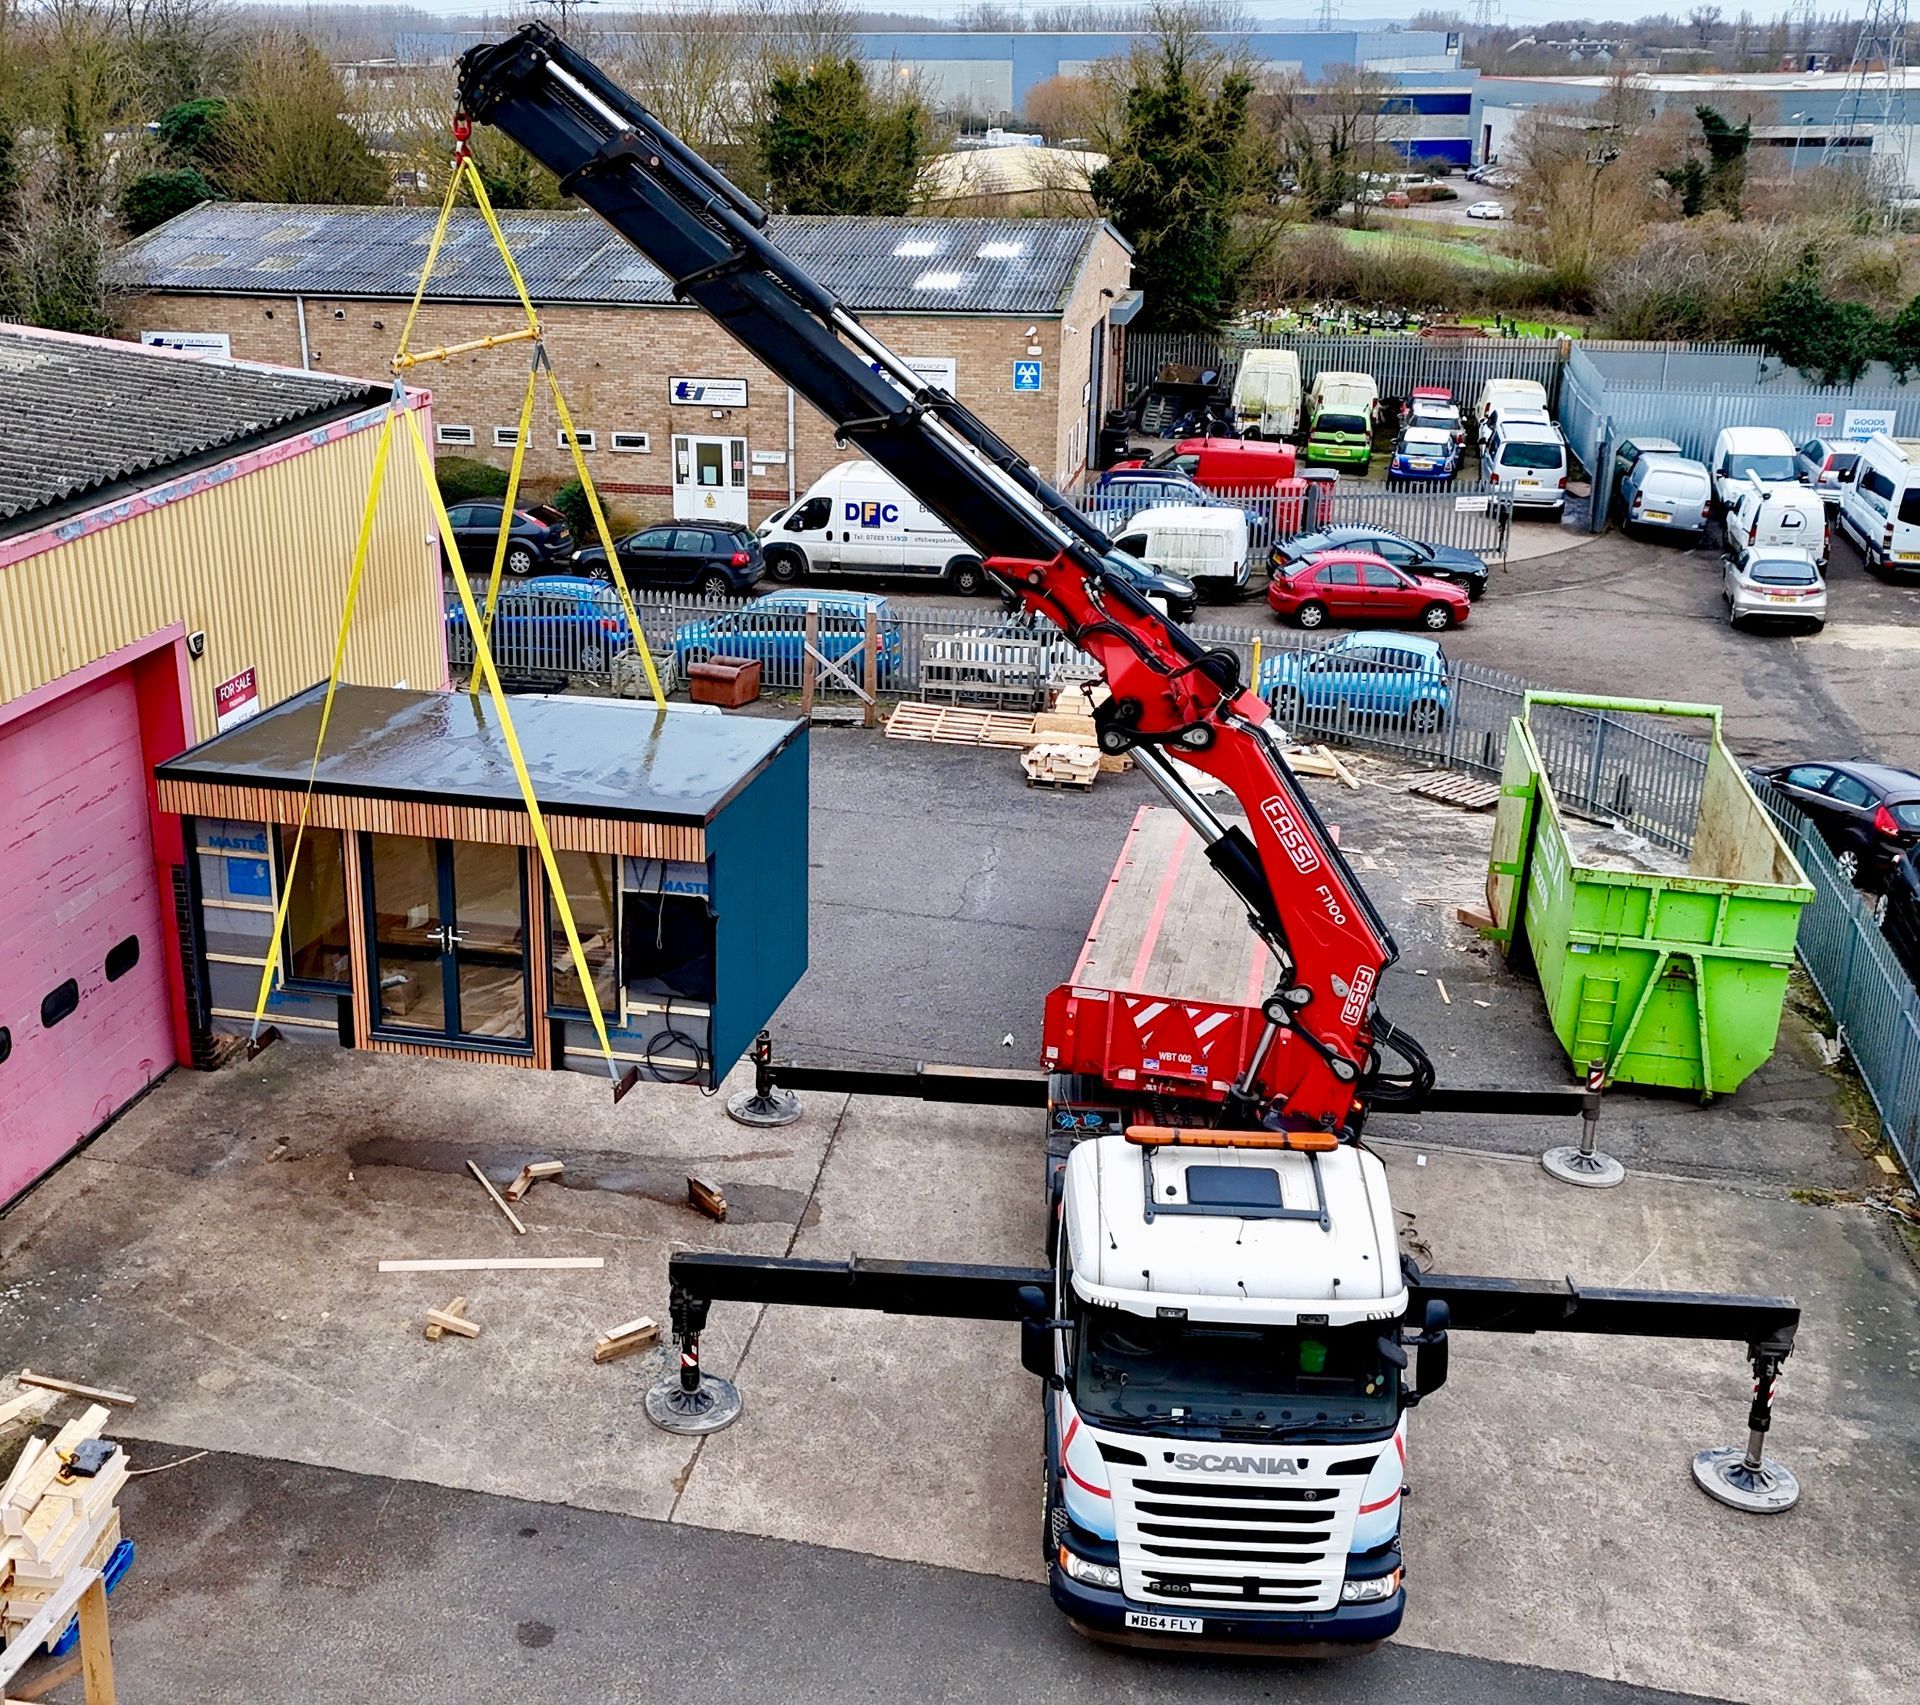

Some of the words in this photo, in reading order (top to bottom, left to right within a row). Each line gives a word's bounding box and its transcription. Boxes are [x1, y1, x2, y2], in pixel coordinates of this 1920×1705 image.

[1848, 426, 1887, 434] INWARDS
[1853, 418, 1886, 426] GOODS
[845, 502, 899, 522] DFC
[220, 682, 235, 702] FOR
[235, 673, 252, 693] SALE
[1265, 801, 1316, 869] FASSI
[662, 880, 709, 895] MASTE
[1315, 885, 1346, 925] F1100
[1344, 969, 1372, 1023] FASSI
[1158, 1051, 1177, 1062] WBT
[1178, 1053, 1192, 1063] 002
[1175, 1453, 1298, 1475] SCANIA
[1152, 1583, 1161, 1591] R
[1131, 1615, 1166, 1628] WB64
[1170, 1619, 1197, 1630] FLY
